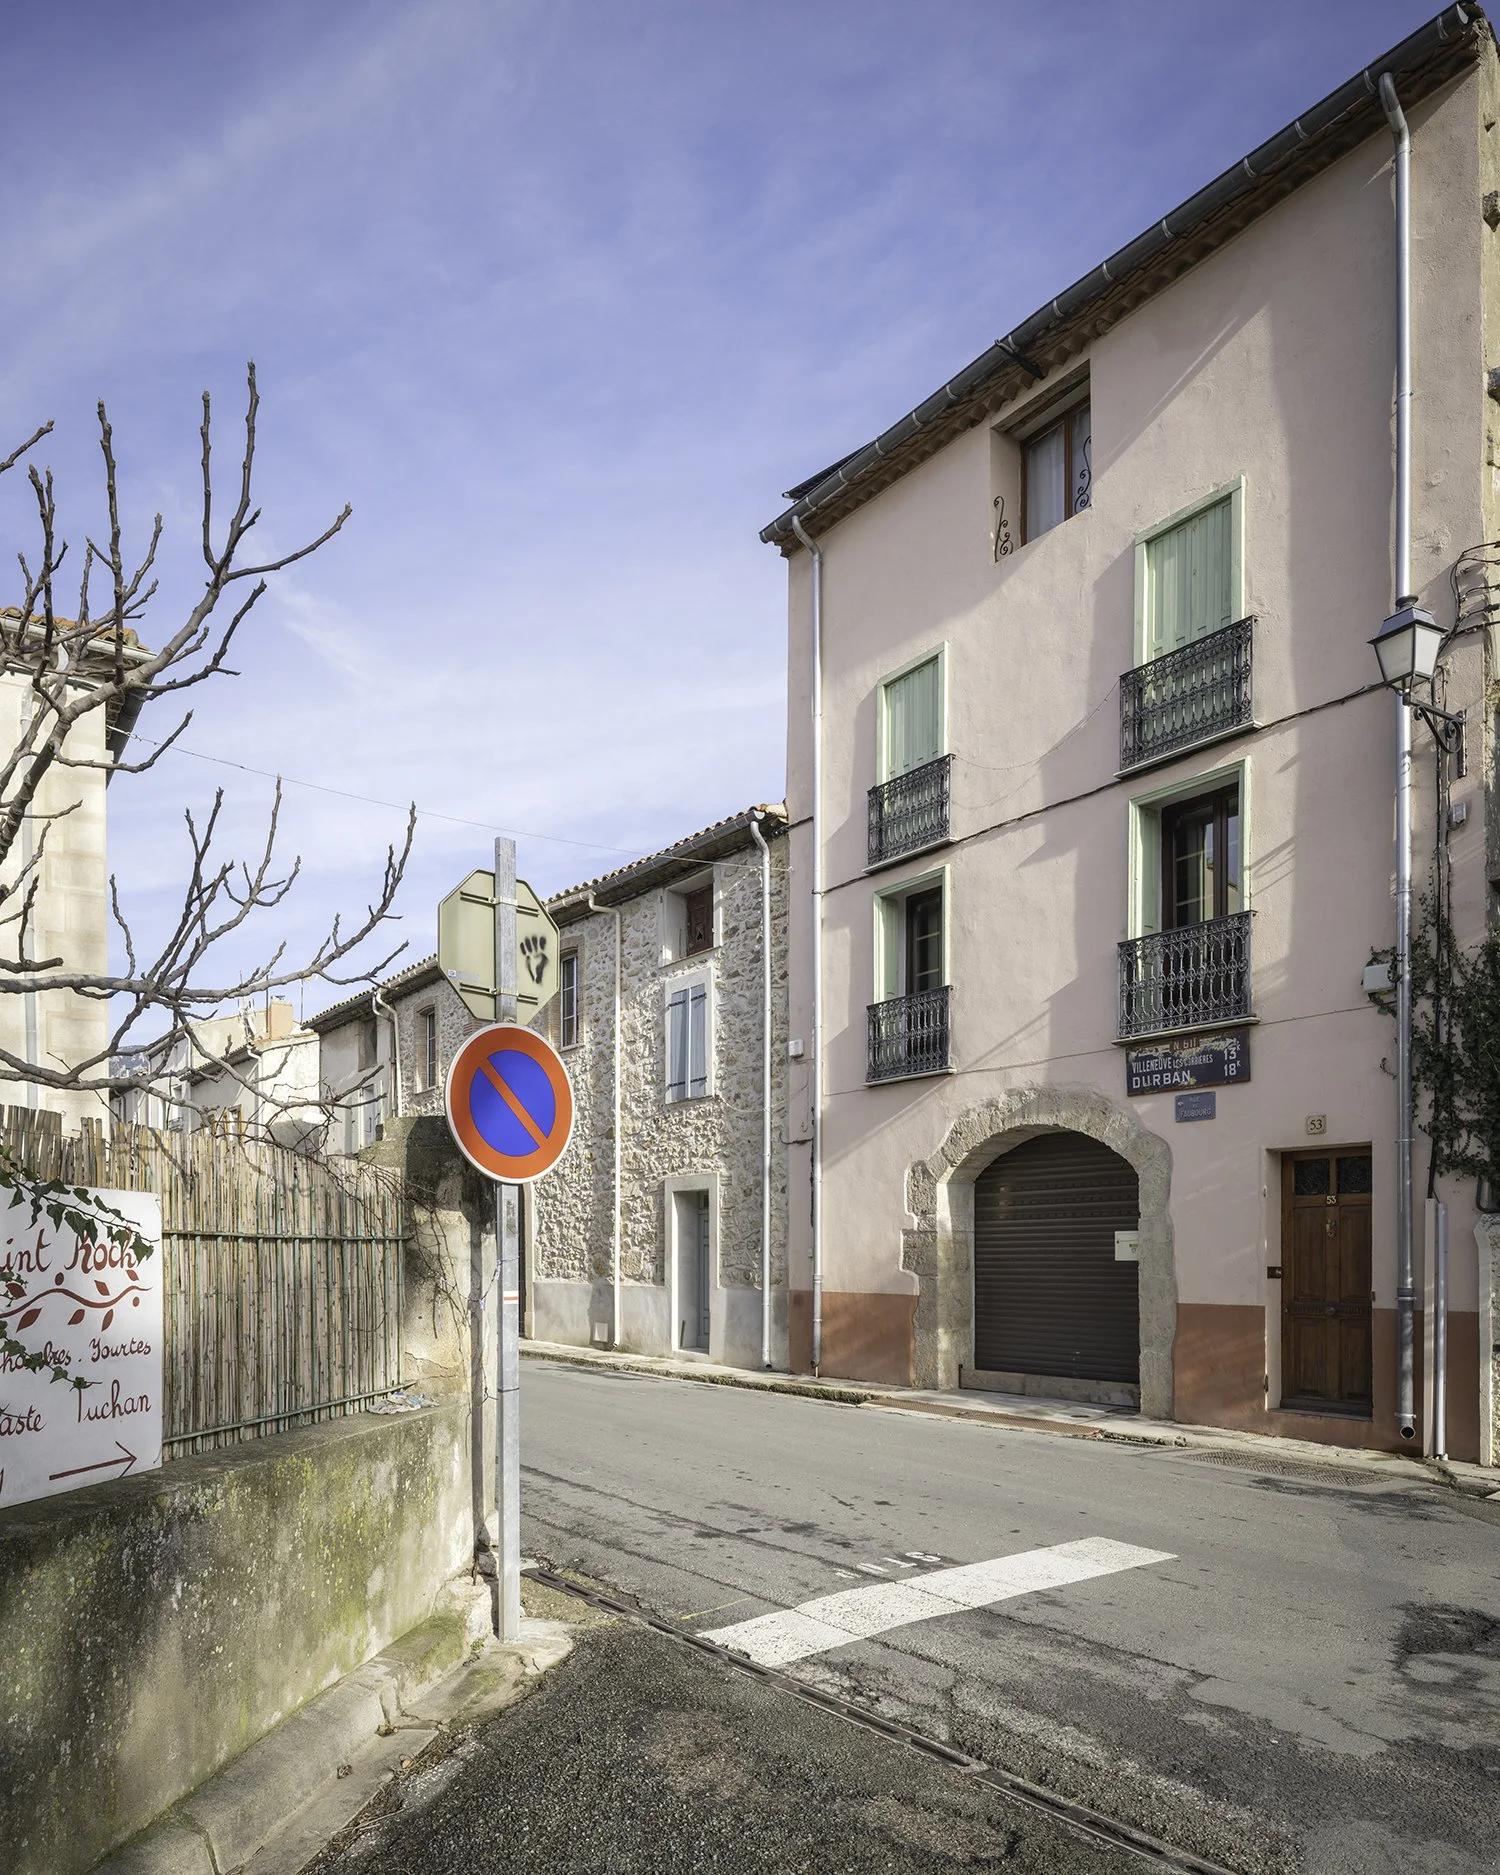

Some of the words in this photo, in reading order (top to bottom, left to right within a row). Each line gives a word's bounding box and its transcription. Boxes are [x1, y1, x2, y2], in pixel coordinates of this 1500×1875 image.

[1132, 1057, 1172, 1074] VILLENEUVE
[1132, 1070, 1190, 1088] DURBAN
[1180, 1107, 1212, 1118] FAUBOURG
[1310, 1119, 1323, 1130] 53
[1326, 1195, 1337, 1204] 53
[0, 1228, 51, 1273] int
[89, 1337, 152, 1363] Yourtes
[0, 1403, 47, 1436] aste
[69, 1379, 152, 1423] Tuchan
